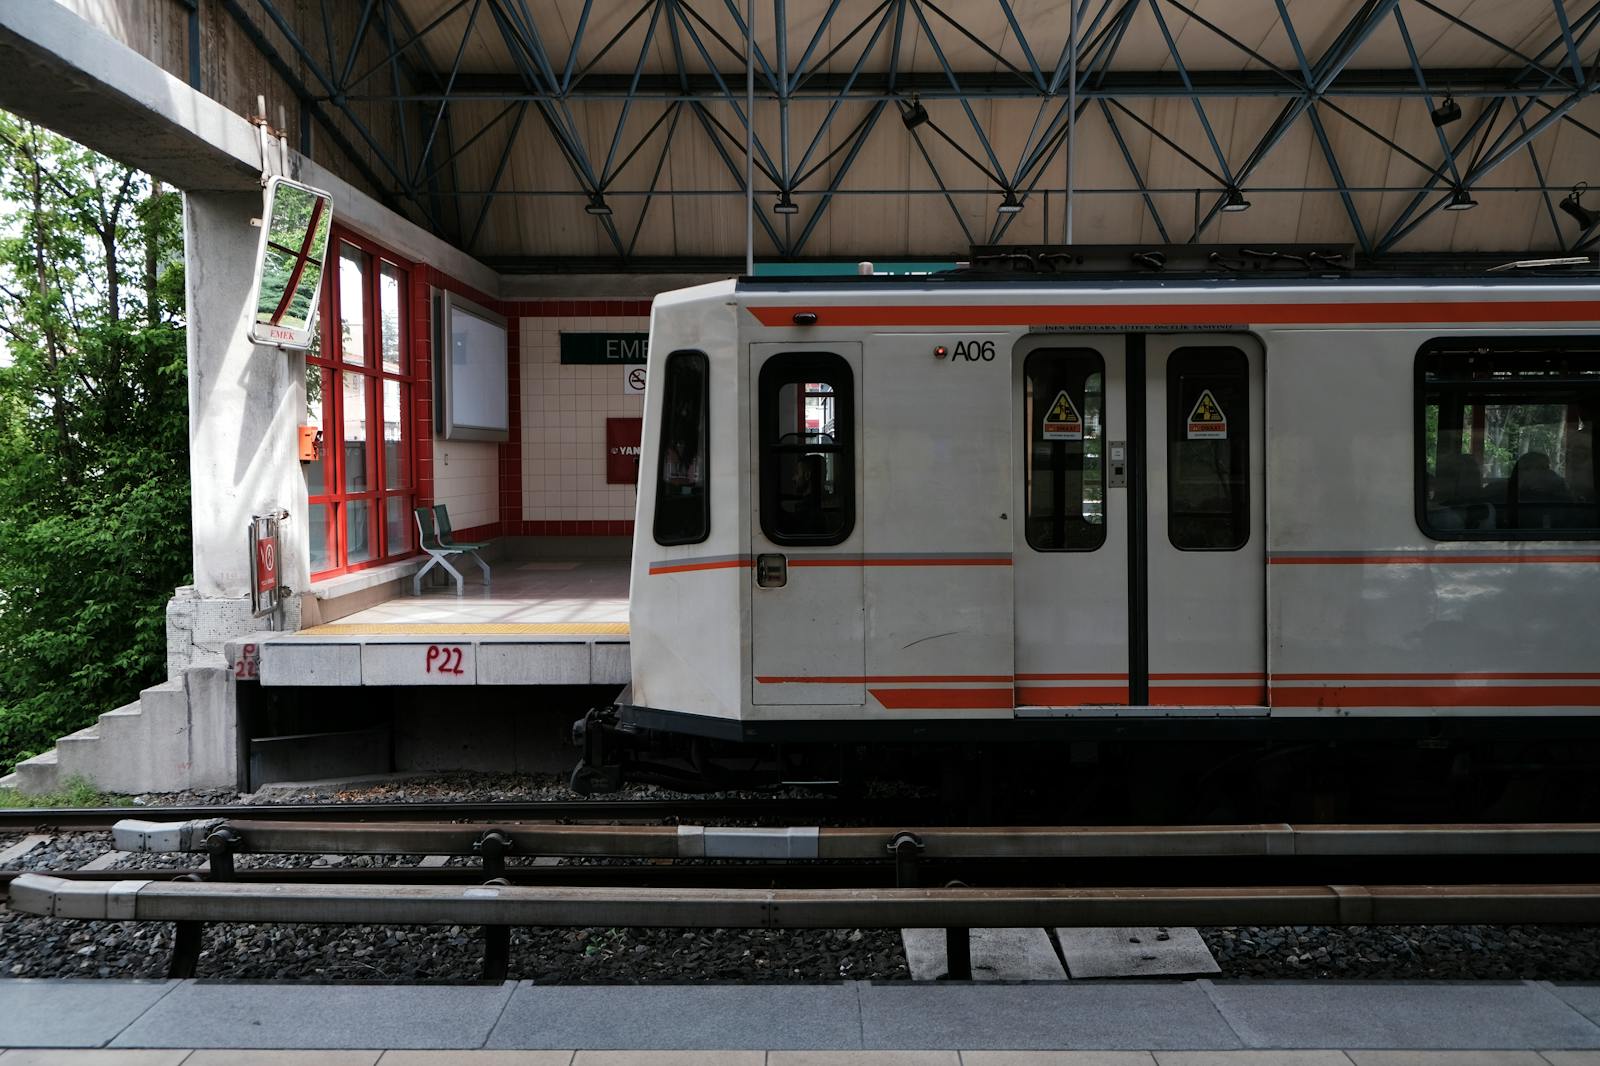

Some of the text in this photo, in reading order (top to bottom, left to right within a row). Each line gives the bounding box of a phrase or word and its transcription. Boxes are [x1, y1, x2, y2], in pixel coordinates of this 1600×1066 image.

[270, 329, 295, 340] EMEK
[951, 340, 996, 362] A06
[426, 645, 464, 675] P22
